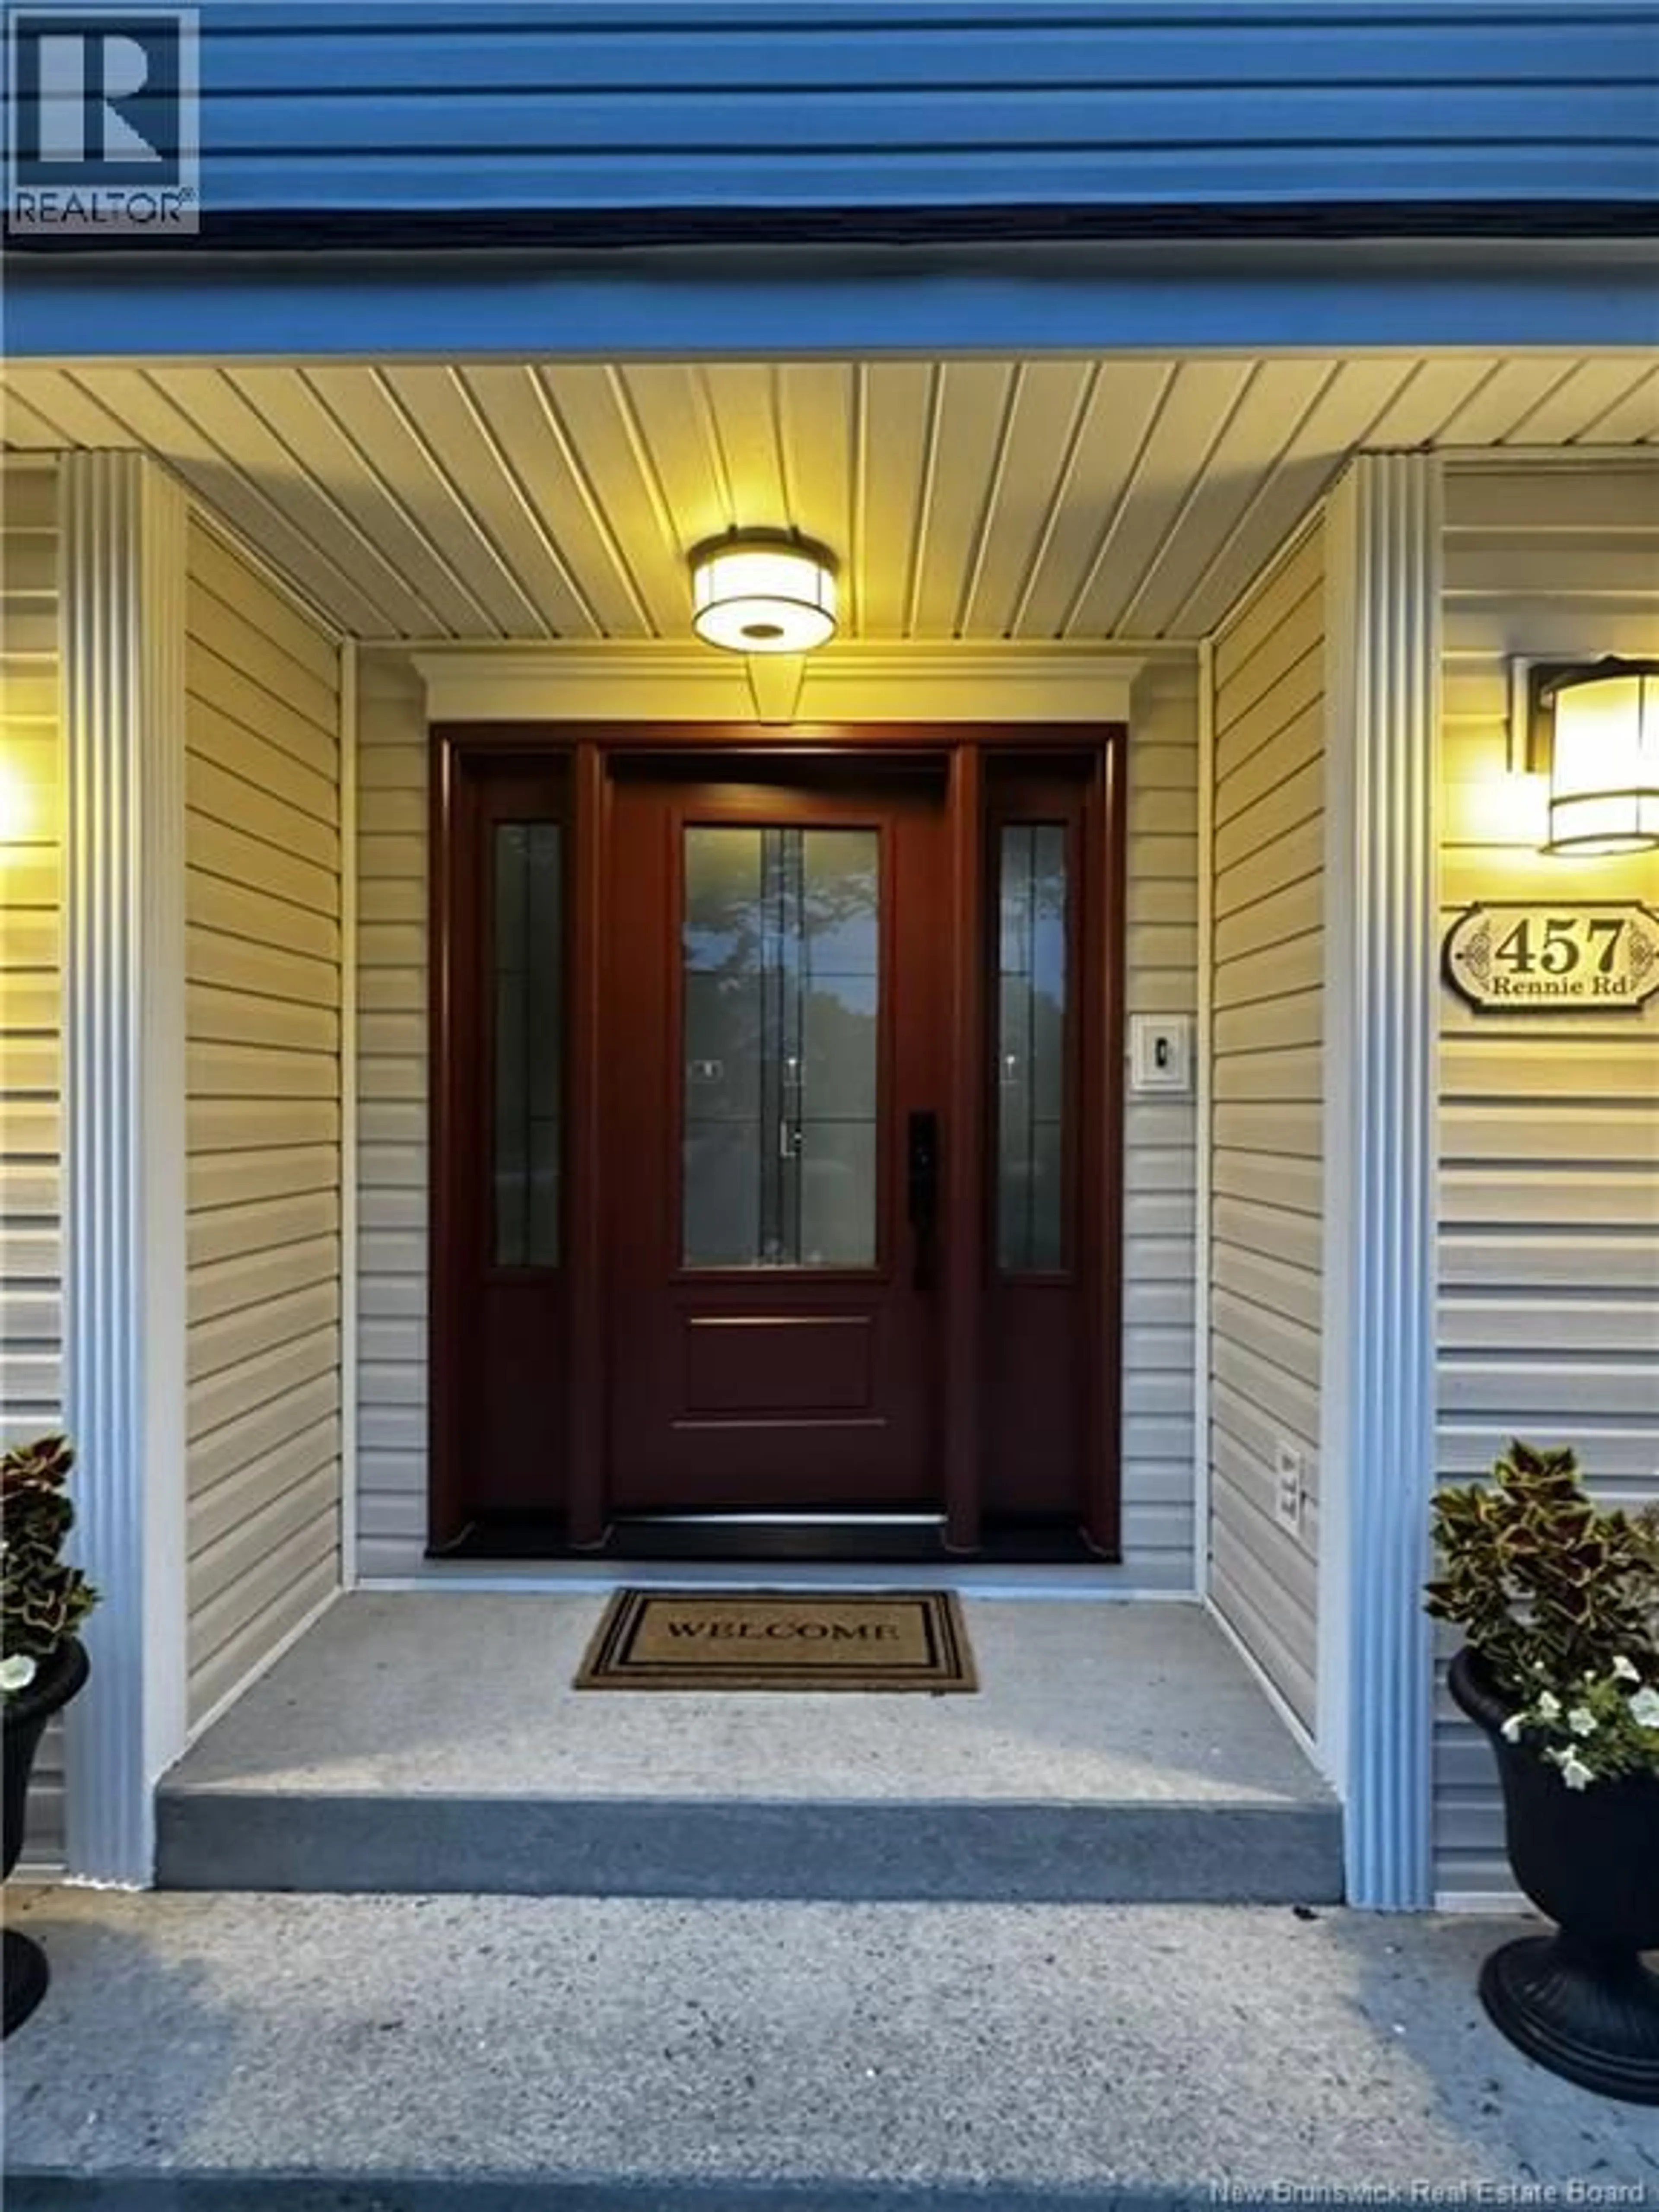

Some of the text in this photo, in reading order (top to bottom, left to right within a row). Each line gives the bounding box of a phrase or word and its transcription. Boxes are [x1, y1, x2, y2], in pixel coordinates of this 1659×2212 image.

[1495, 918, 1625, 974] 457
[1492, 976, 1627, 994] Rennie Rd
[668, 1621, 900, 1640] WELCOME
